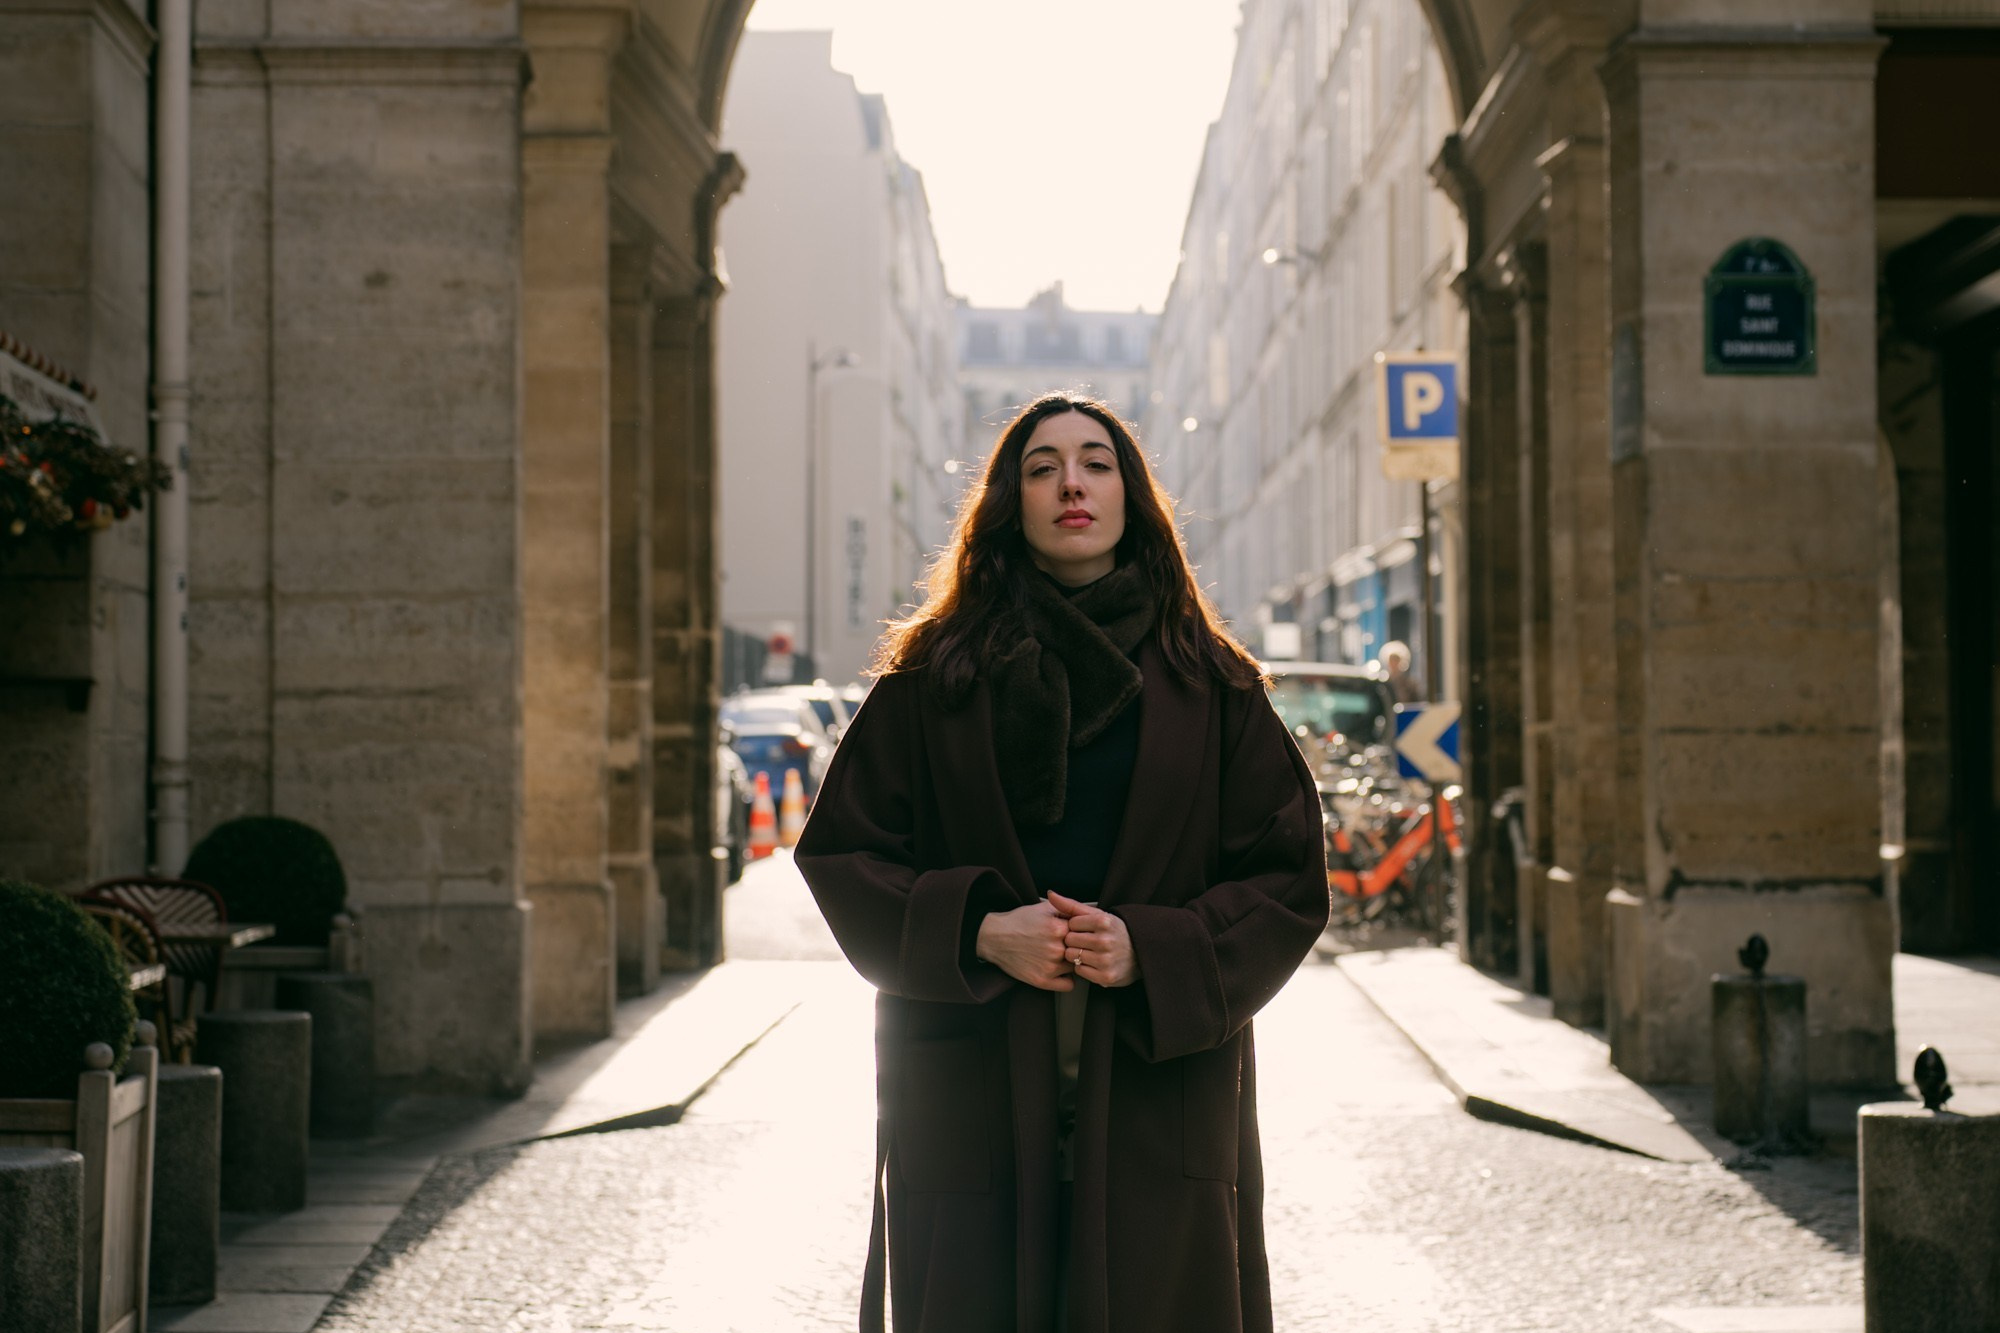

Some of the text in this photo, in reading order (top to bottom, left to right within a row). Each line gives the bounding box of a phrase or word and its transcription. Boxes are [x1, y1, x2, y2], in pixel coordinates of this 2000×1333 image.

[1745, 294, 1772, 311] RUE
[1740, 317, 1779, 334] SAINT
[1722, 340, 1796, 358] DOMINIQUE
[1402, 371, 1444, 431] P
